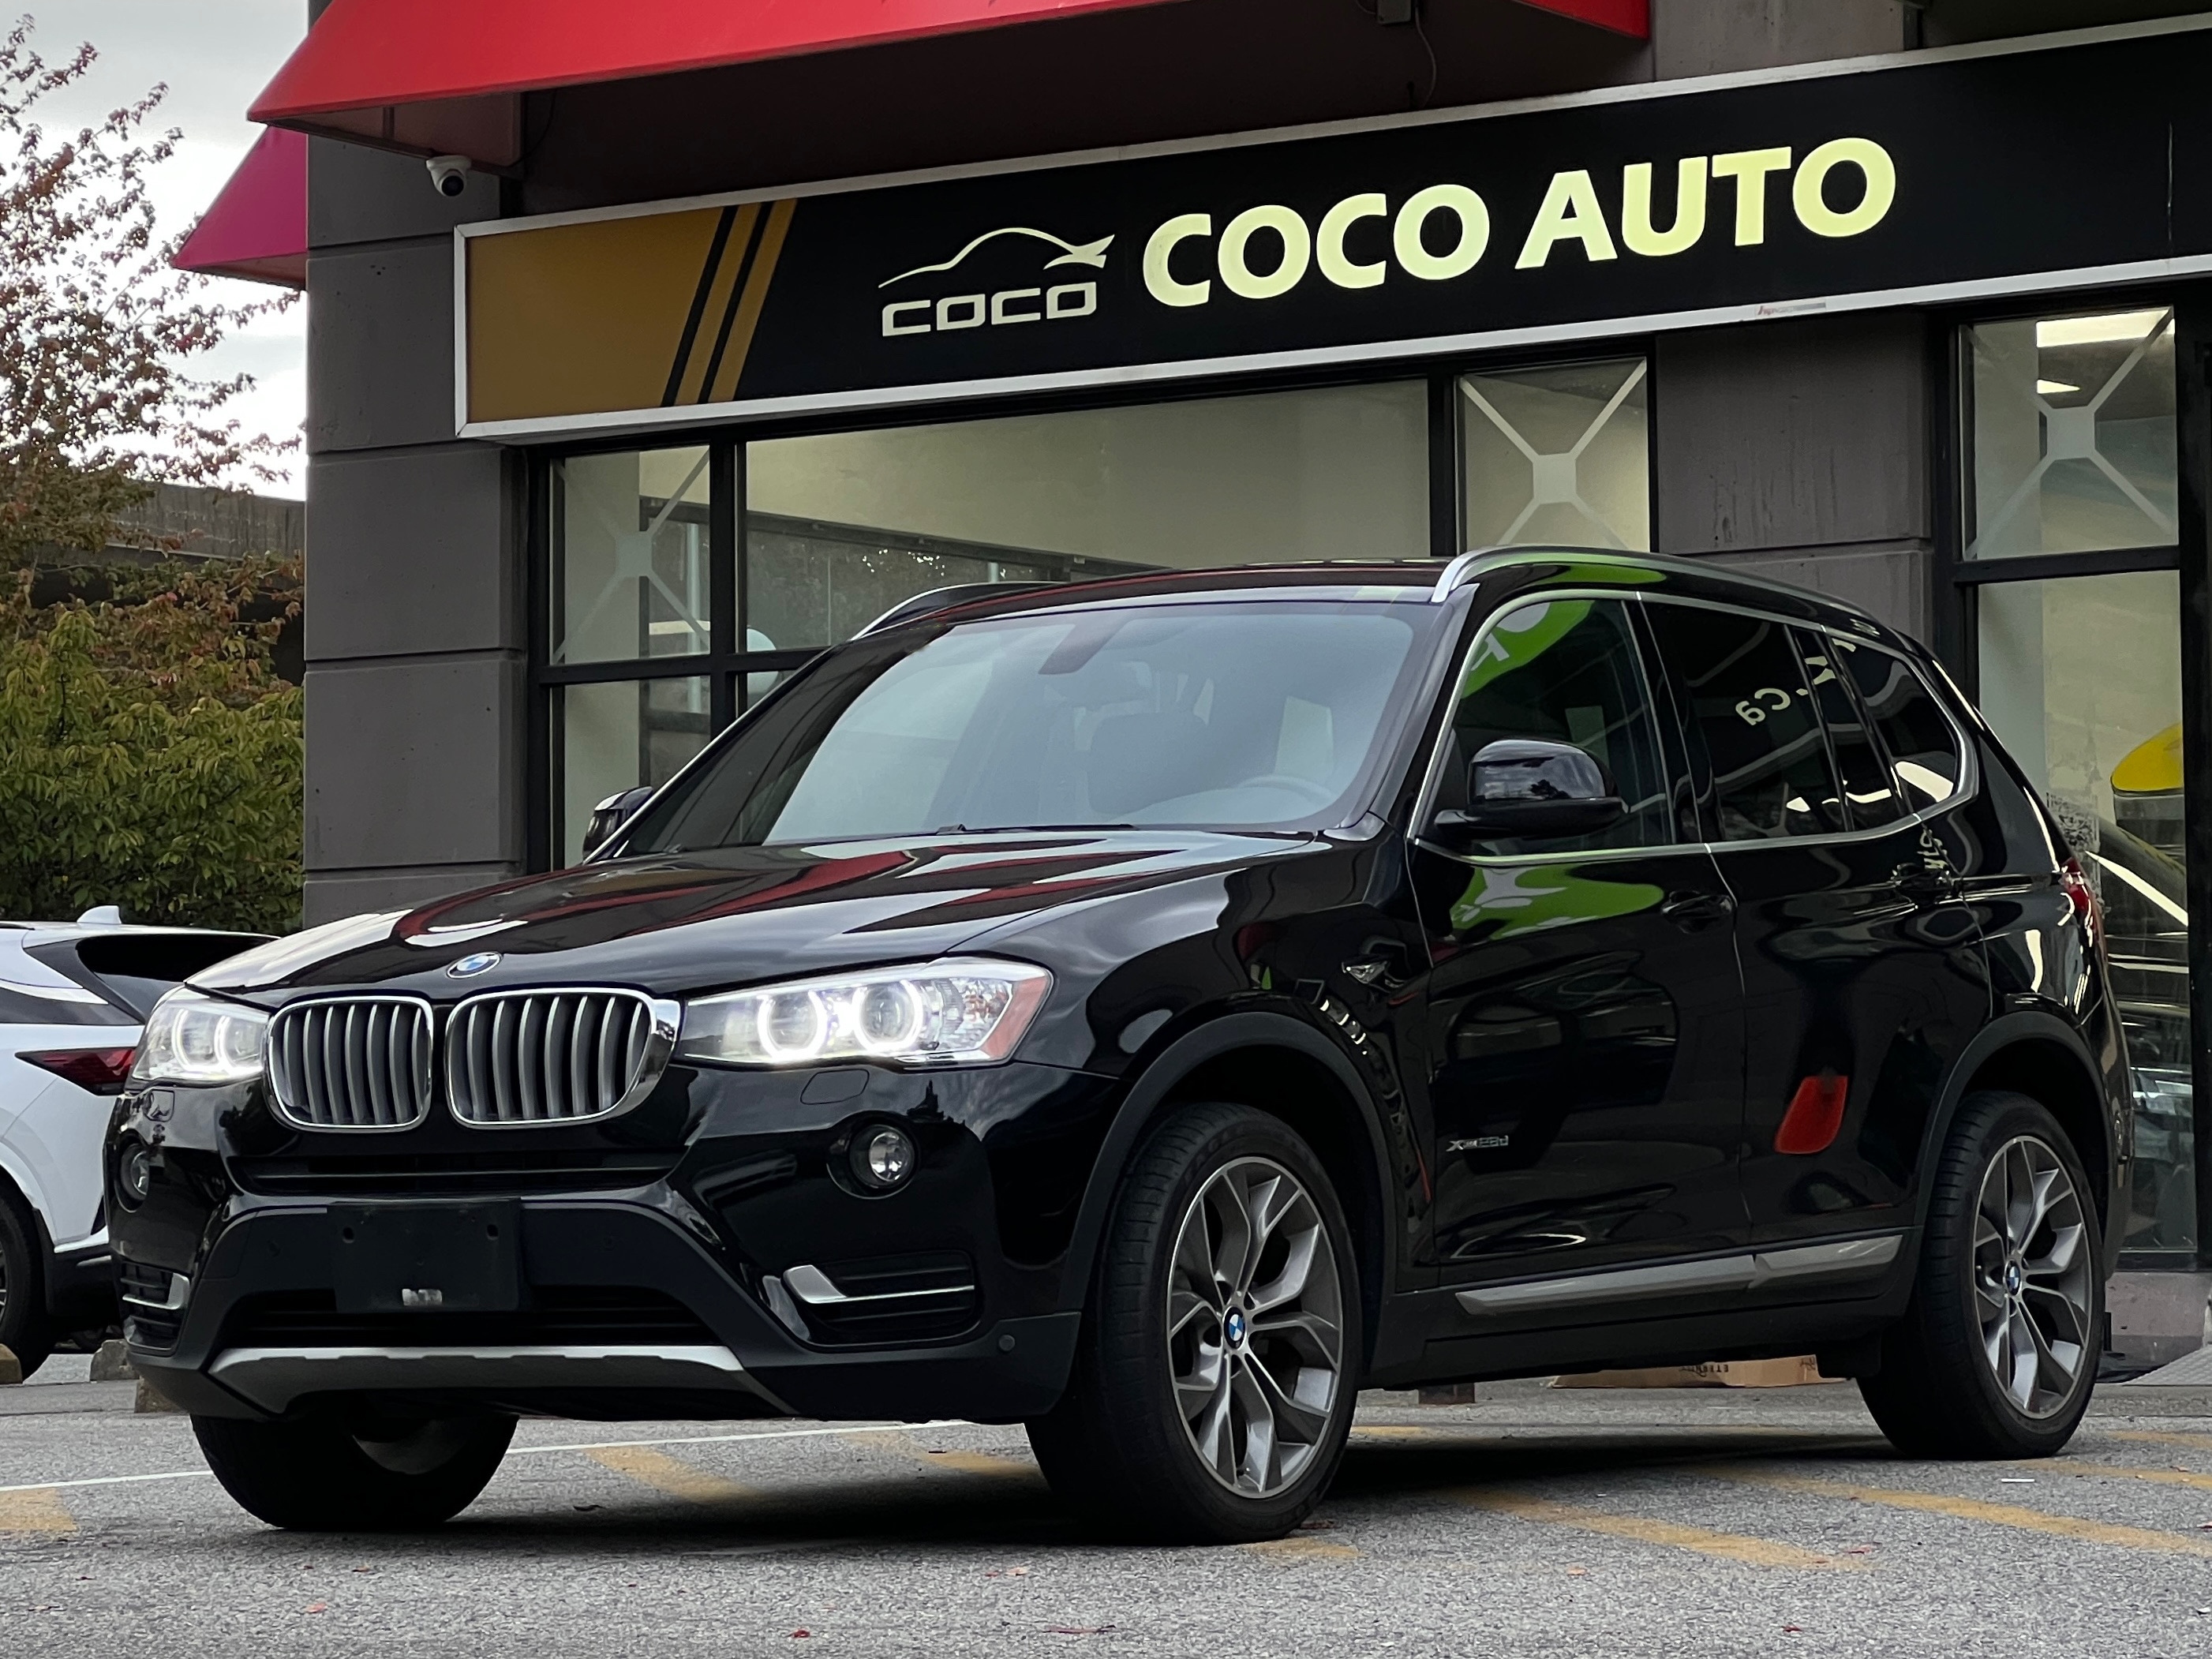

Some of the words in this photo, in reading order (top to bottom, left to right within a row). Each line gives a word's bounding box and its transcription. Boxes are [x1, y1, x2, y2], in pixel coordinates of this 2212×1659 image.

[1142, 184, 1491, 307] COCO
[1514, 137, 1897, 271] AUTO
[881, 281, 1097, 338] COCO
